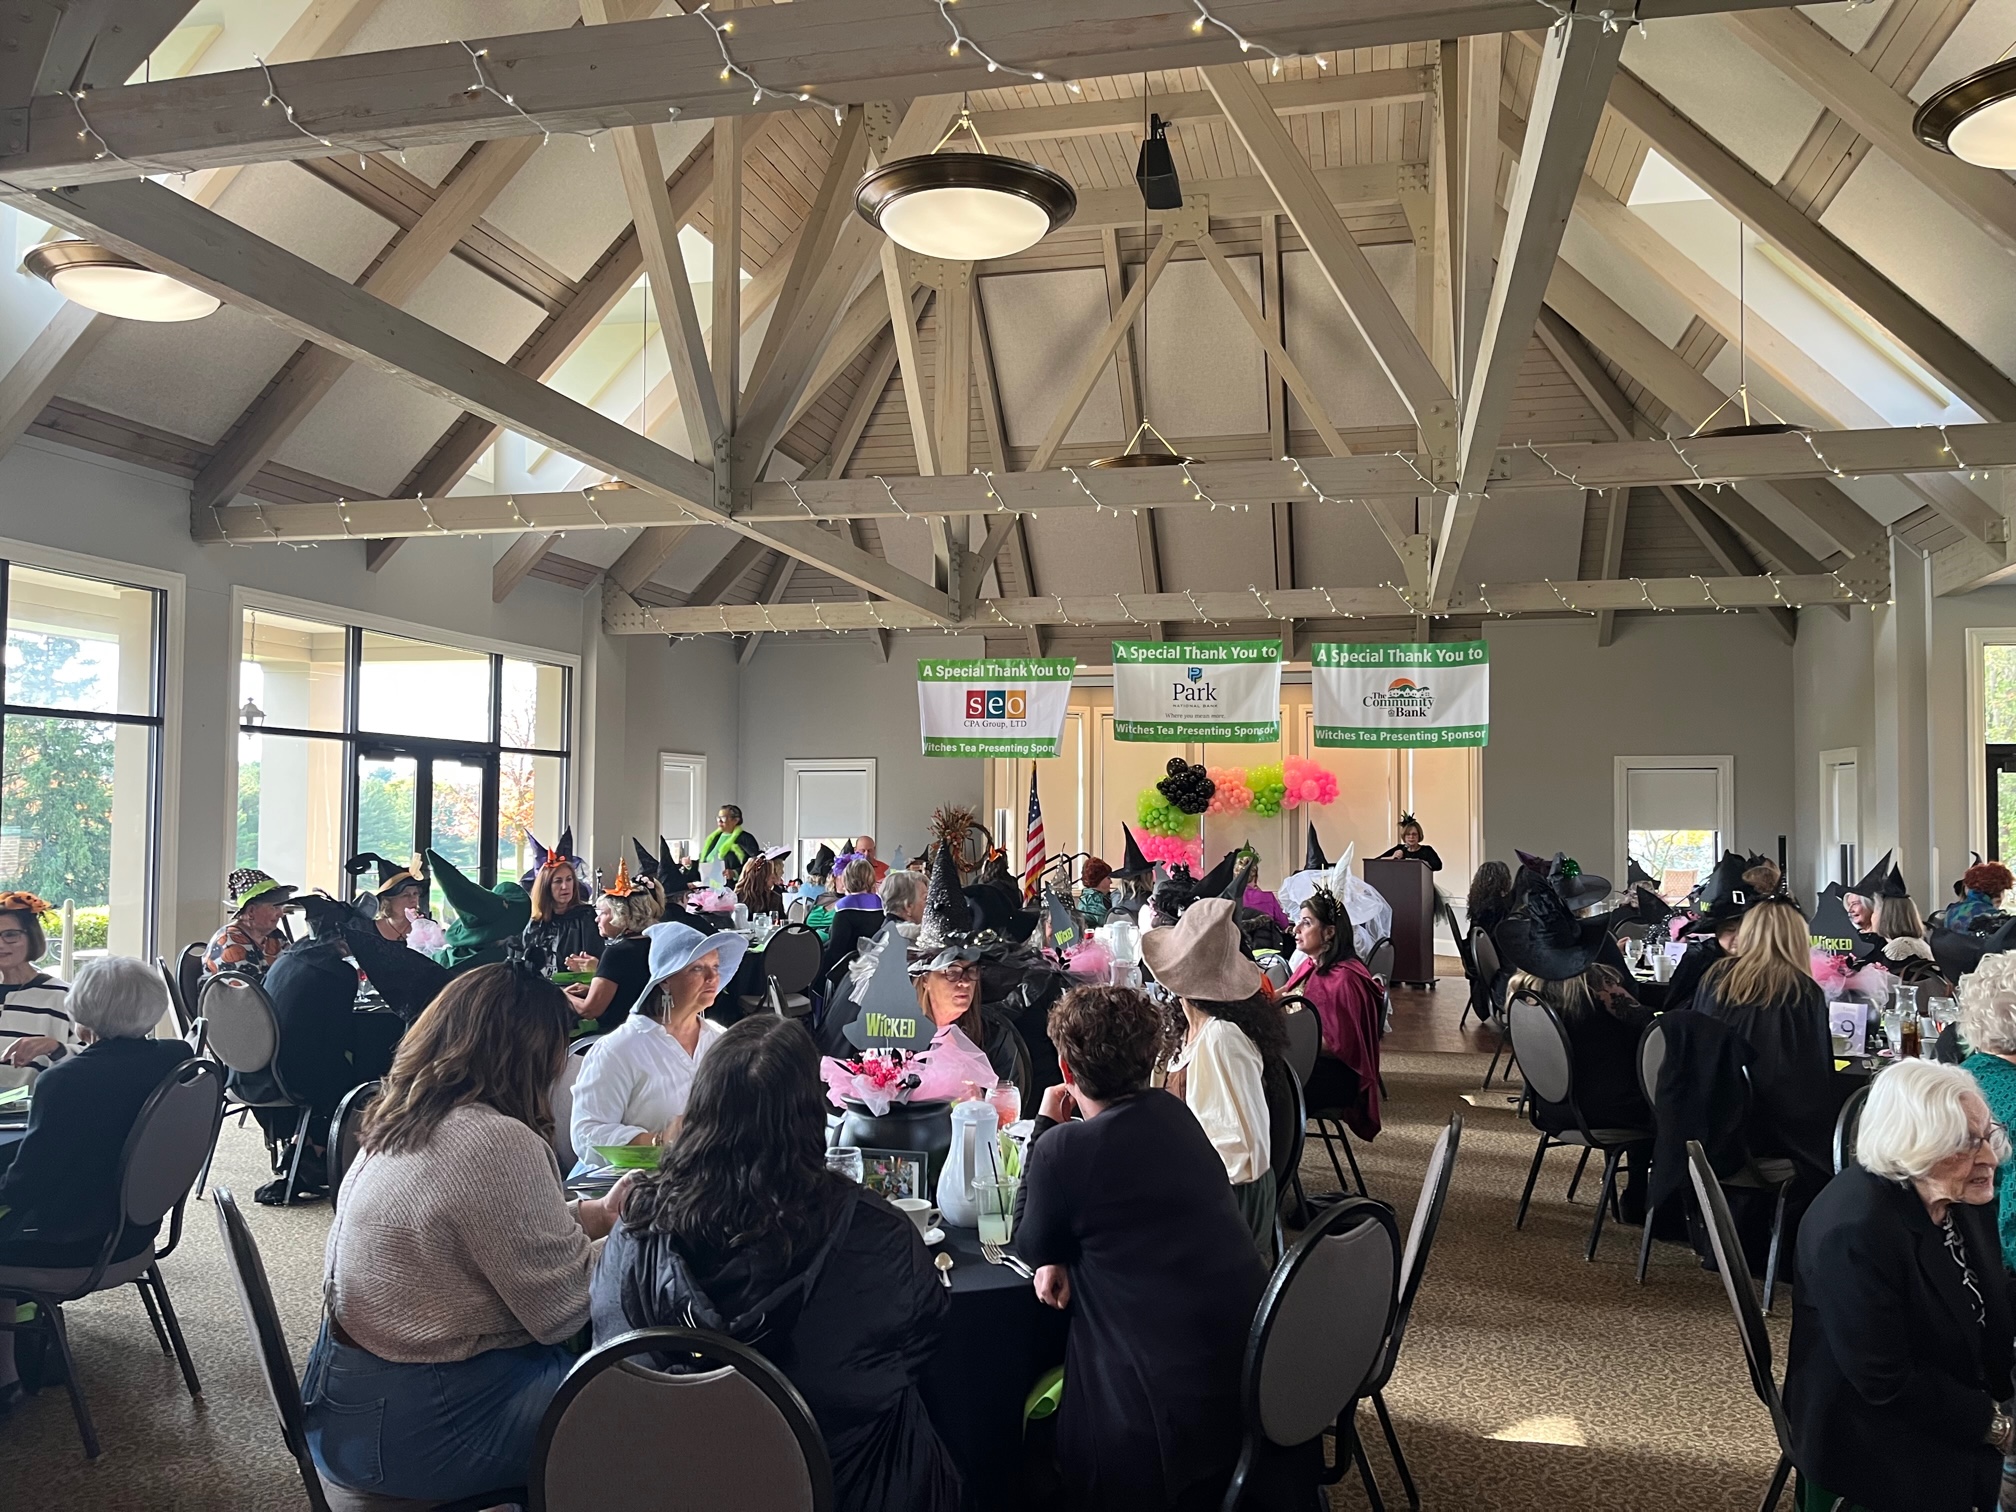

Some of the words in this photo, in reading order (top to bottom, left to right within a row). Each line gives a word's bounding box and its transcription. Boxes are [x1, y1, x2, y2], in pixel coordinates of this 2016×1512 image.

[1117, 647, 1127, 658] A
[1130, 646, 1180, 662] Special
[1184, 646, 1227, 659] Thank
[1230, 647, 1257, 658] You
[1261, 646, 1277, 658] to
[1317, 649, 1327, 662] A
[1331, 649, 1383, 665] Special
[1388, 649, 1432, 663] Thank
[1436, 649, 1463, 662] You
[1468, 648, 1483, 660] to
[923, 665, 933, 677] A
[936, 665, 984, 679] Special
[987, 665, 1027, 677] Thank
[1030, 664, 1053, 676] You
[1057, 665, 1070, 676] to
[1172, 682, 1217, 701] Park
[969, 696, 1025, 715] seo
[1363, 696, 1434, 709] Community
[1396, 707, 1427, 717] Bank
[982, 720, 1008, 729] Group,
[1116, 723, 1154, 735] Witches
[1156, 726, 1174, 735] Tea
[1177, 726, 1231, 737] Presenting
[1234, 726, 1274, 736] Sponsor
[1316, 729, 1356, 740] Witches
[1358, 731, 1377, 741] Tea
[1380, 732, 1438, 742] Presenting
[1441, 730, 1486, 740] Sponsor
[960, 744, 976, 752] Tea
[979, 744, 1028, 754] Presenting
[1841, 1020, 1855, 1039] 9
